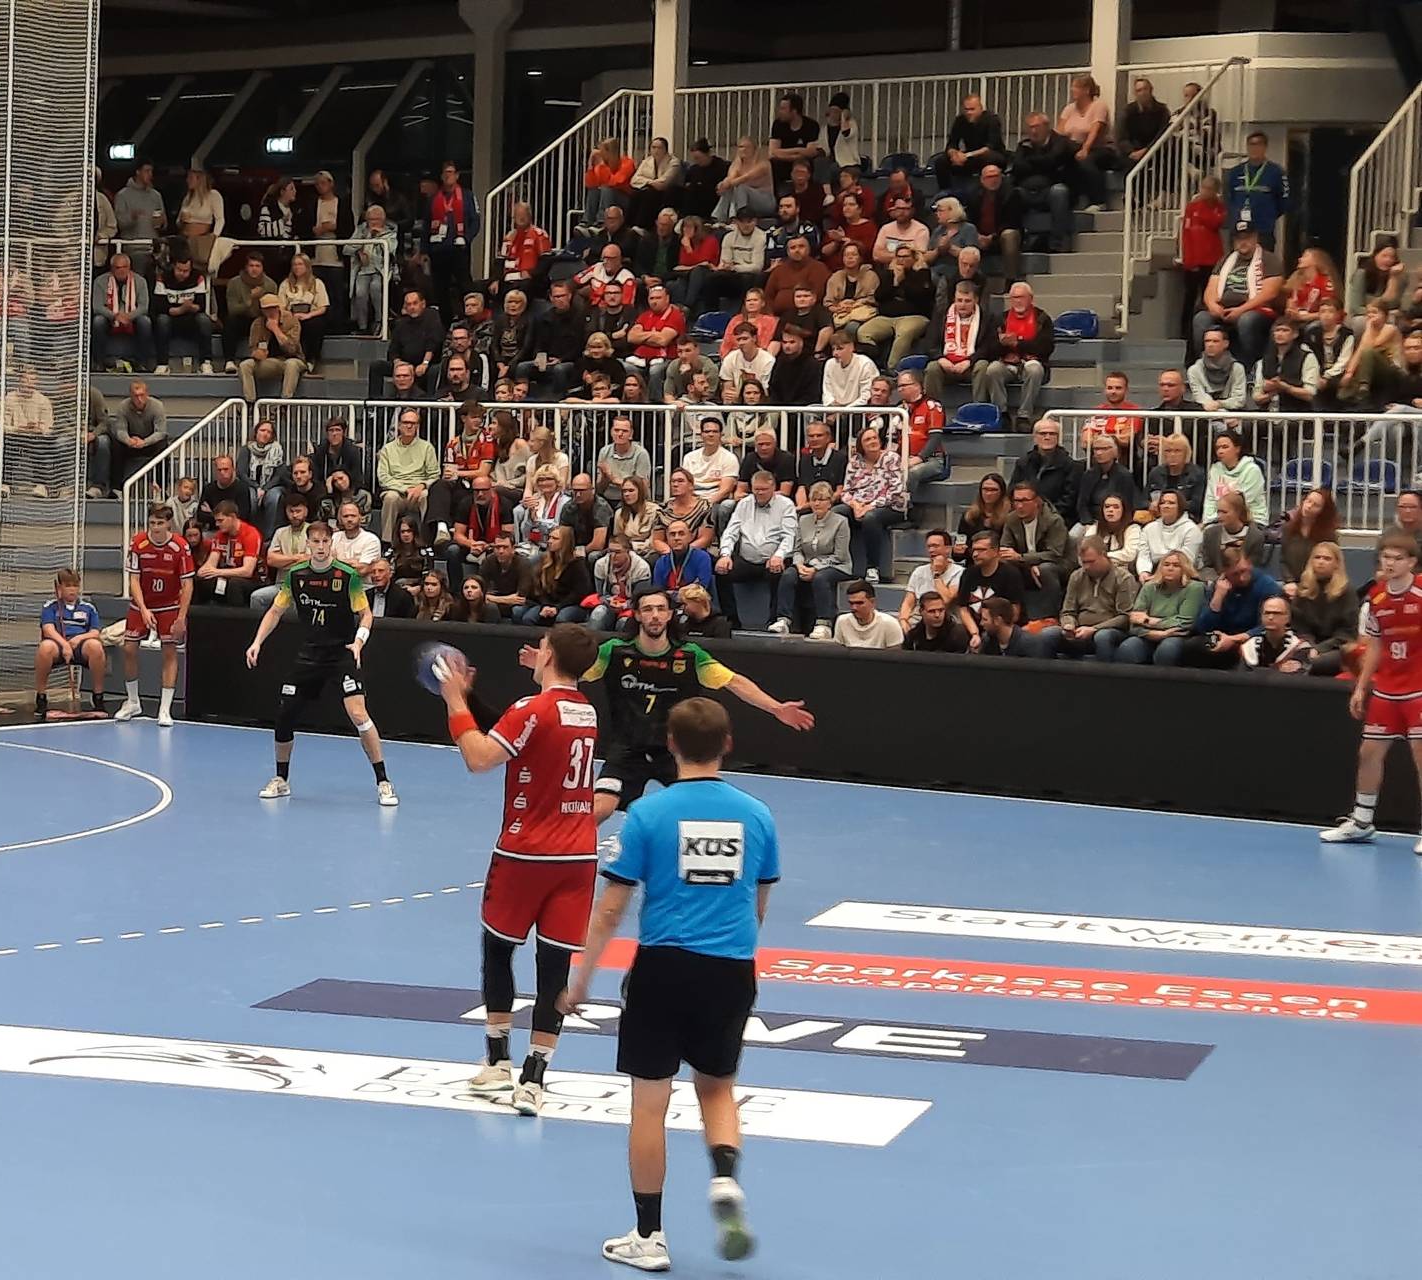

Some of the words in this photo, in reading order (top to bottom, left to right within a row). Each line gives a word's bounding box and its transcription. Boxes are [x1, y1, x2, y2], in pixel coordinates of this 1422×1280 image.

[311, 608, 325, 626] 74
[645, 694, 657, 714] 7
[562, 737, 595, 790] 37
[758, 971, 1360, 1020] www.sparkasse-essen.de
[770, 958, 1130, 993] Sparkasse
[1154, 983, 1369, 1010] Essen
